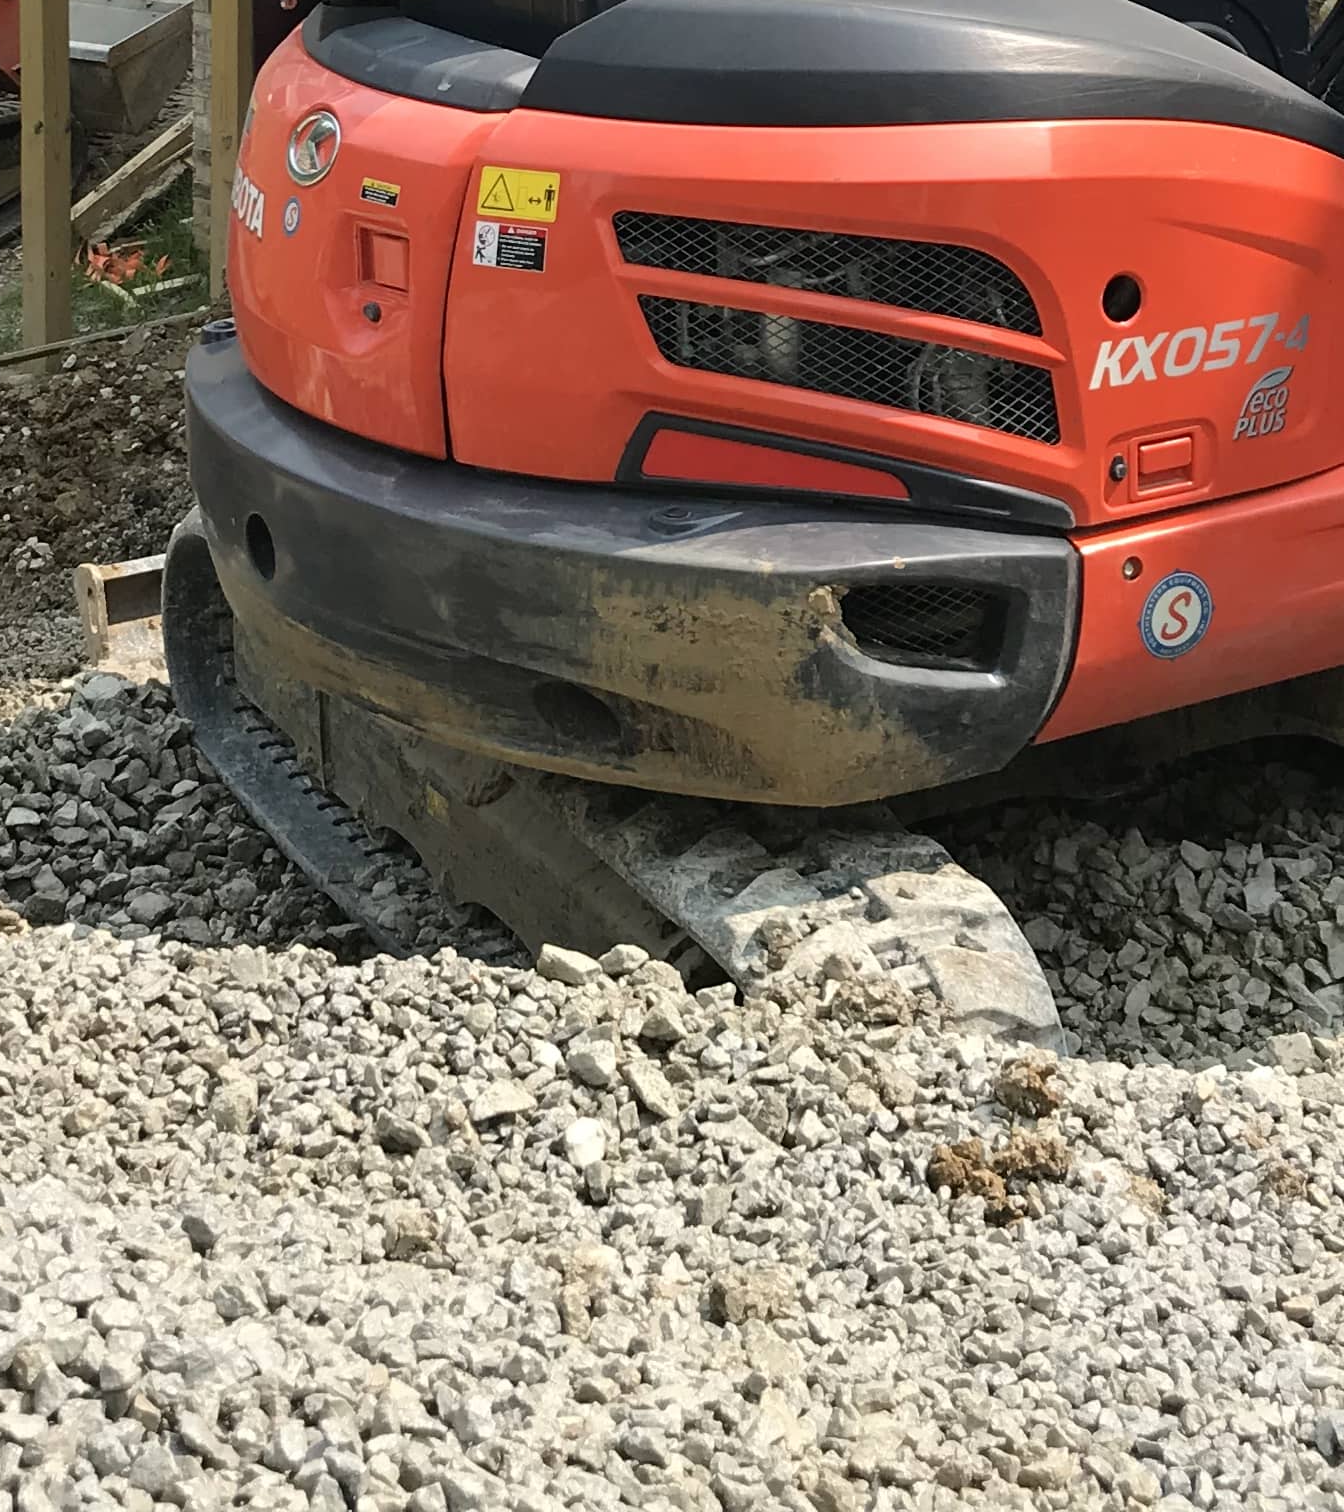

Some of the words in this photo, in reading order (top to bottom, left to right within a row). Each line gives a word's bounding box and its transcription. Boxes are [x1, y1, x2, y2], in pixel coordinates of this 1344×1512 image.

[231, 167, 264, 239] BOTA
[1088, 312, 1311, 391] KX057-4
[1232, 408, 1288, 440] PLUS
[1249, 387, 1289, 414] eco
[1161, 591, 1192, 640] S
